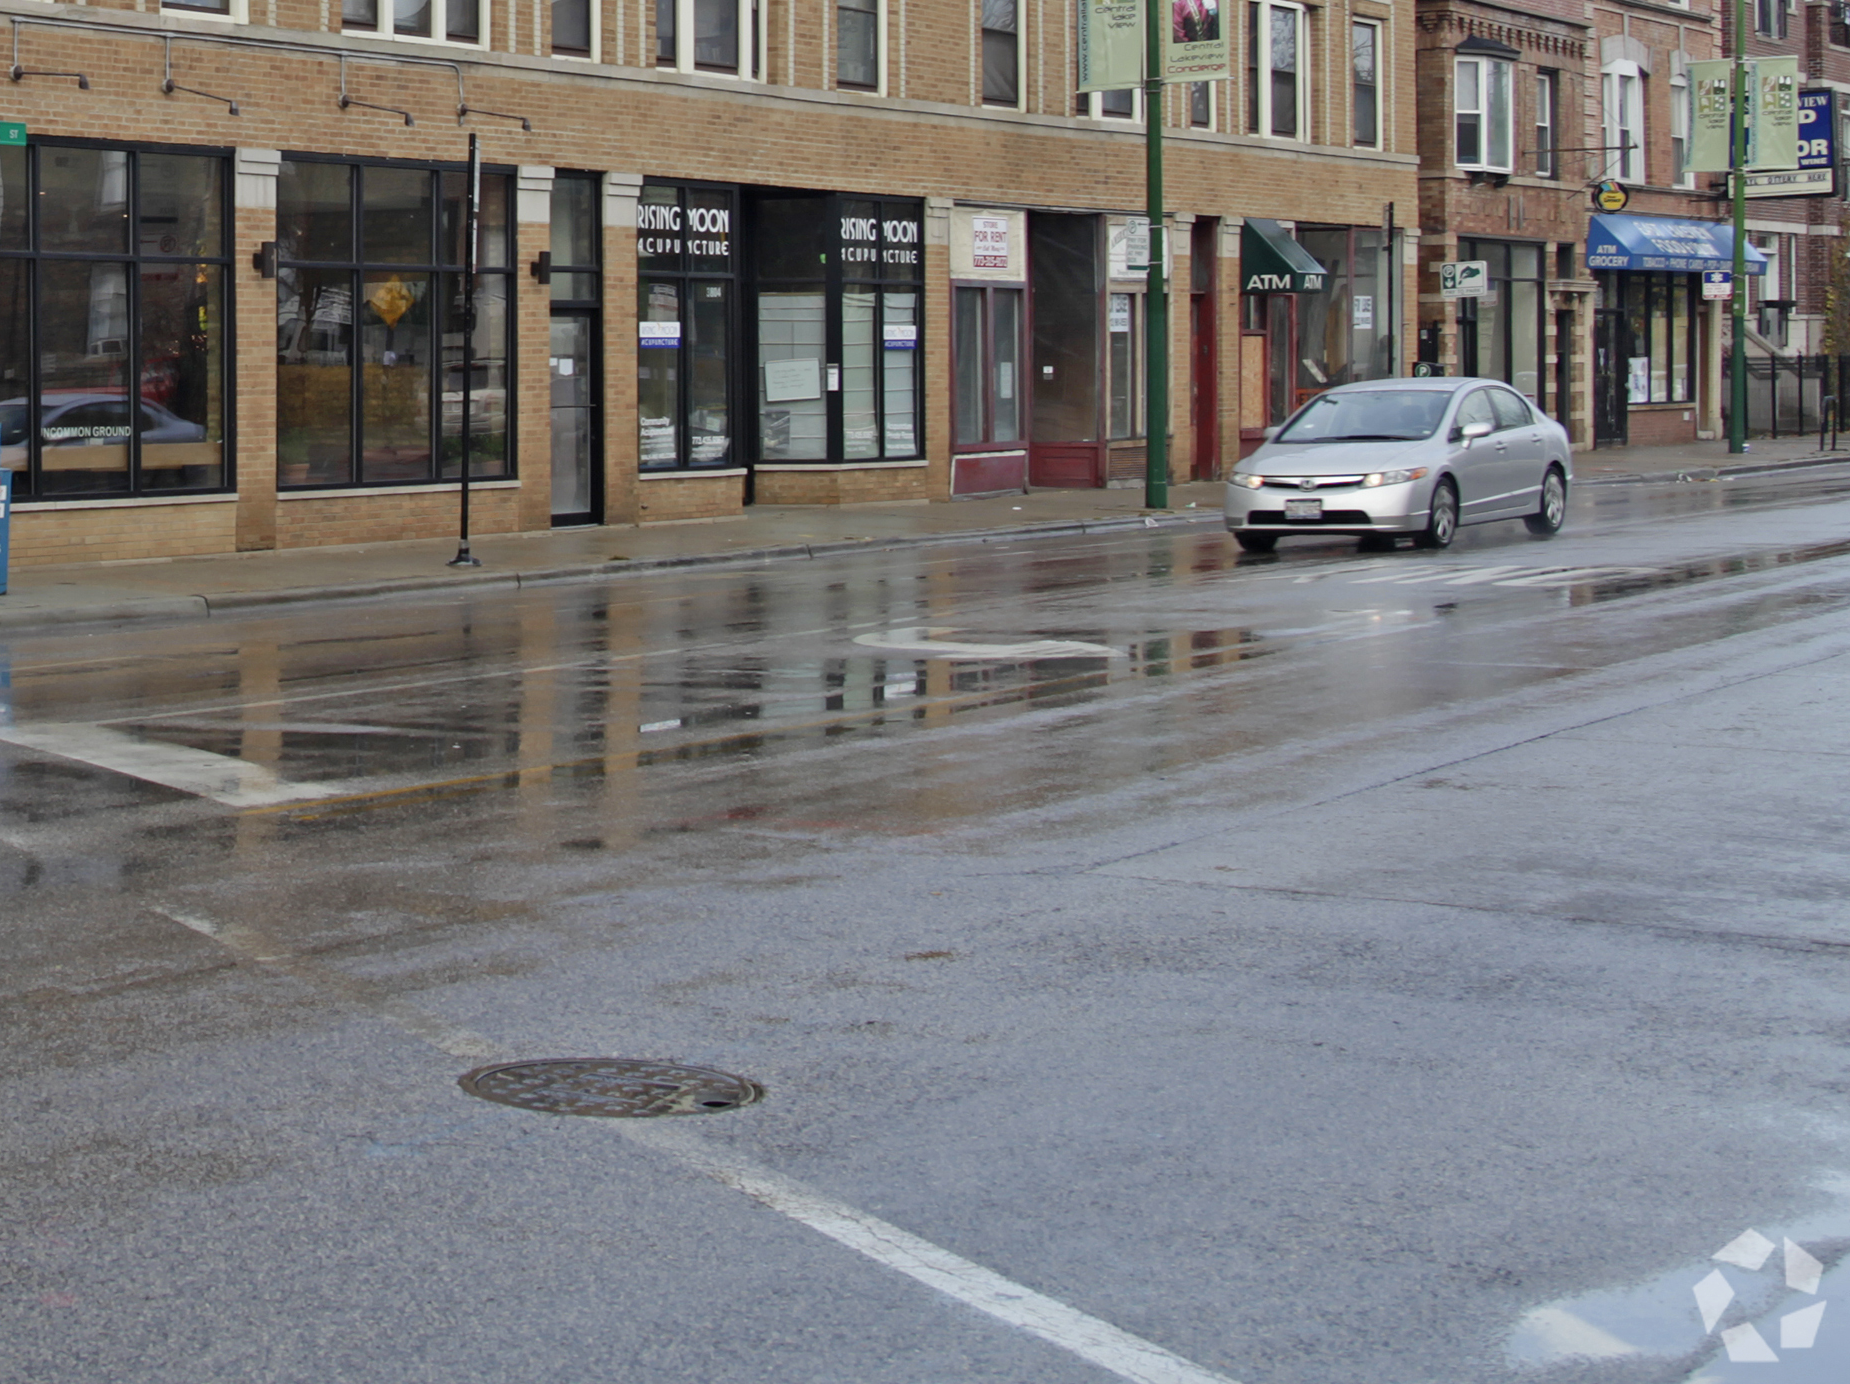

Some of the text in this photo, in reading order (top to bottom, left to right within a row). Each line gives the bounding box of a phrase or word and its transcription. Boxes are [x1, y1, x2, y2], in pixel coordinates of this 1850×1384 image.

[9, 130, 18, 139] ST
[1801, 157, 1828, 165] WINE
[638, 205, 681, 231] RISING
[974, 230, 1007, 243] FOR RENT
[1596, 245, 1617, 254] ATM
[1588, 256, 1630, 266] GROCERY
[1246, 274, 1322, 290] ATM ATM
[640, 338, 678, 346] ACUPUNCTURE
[92, 426, 131, 436] GROUND
